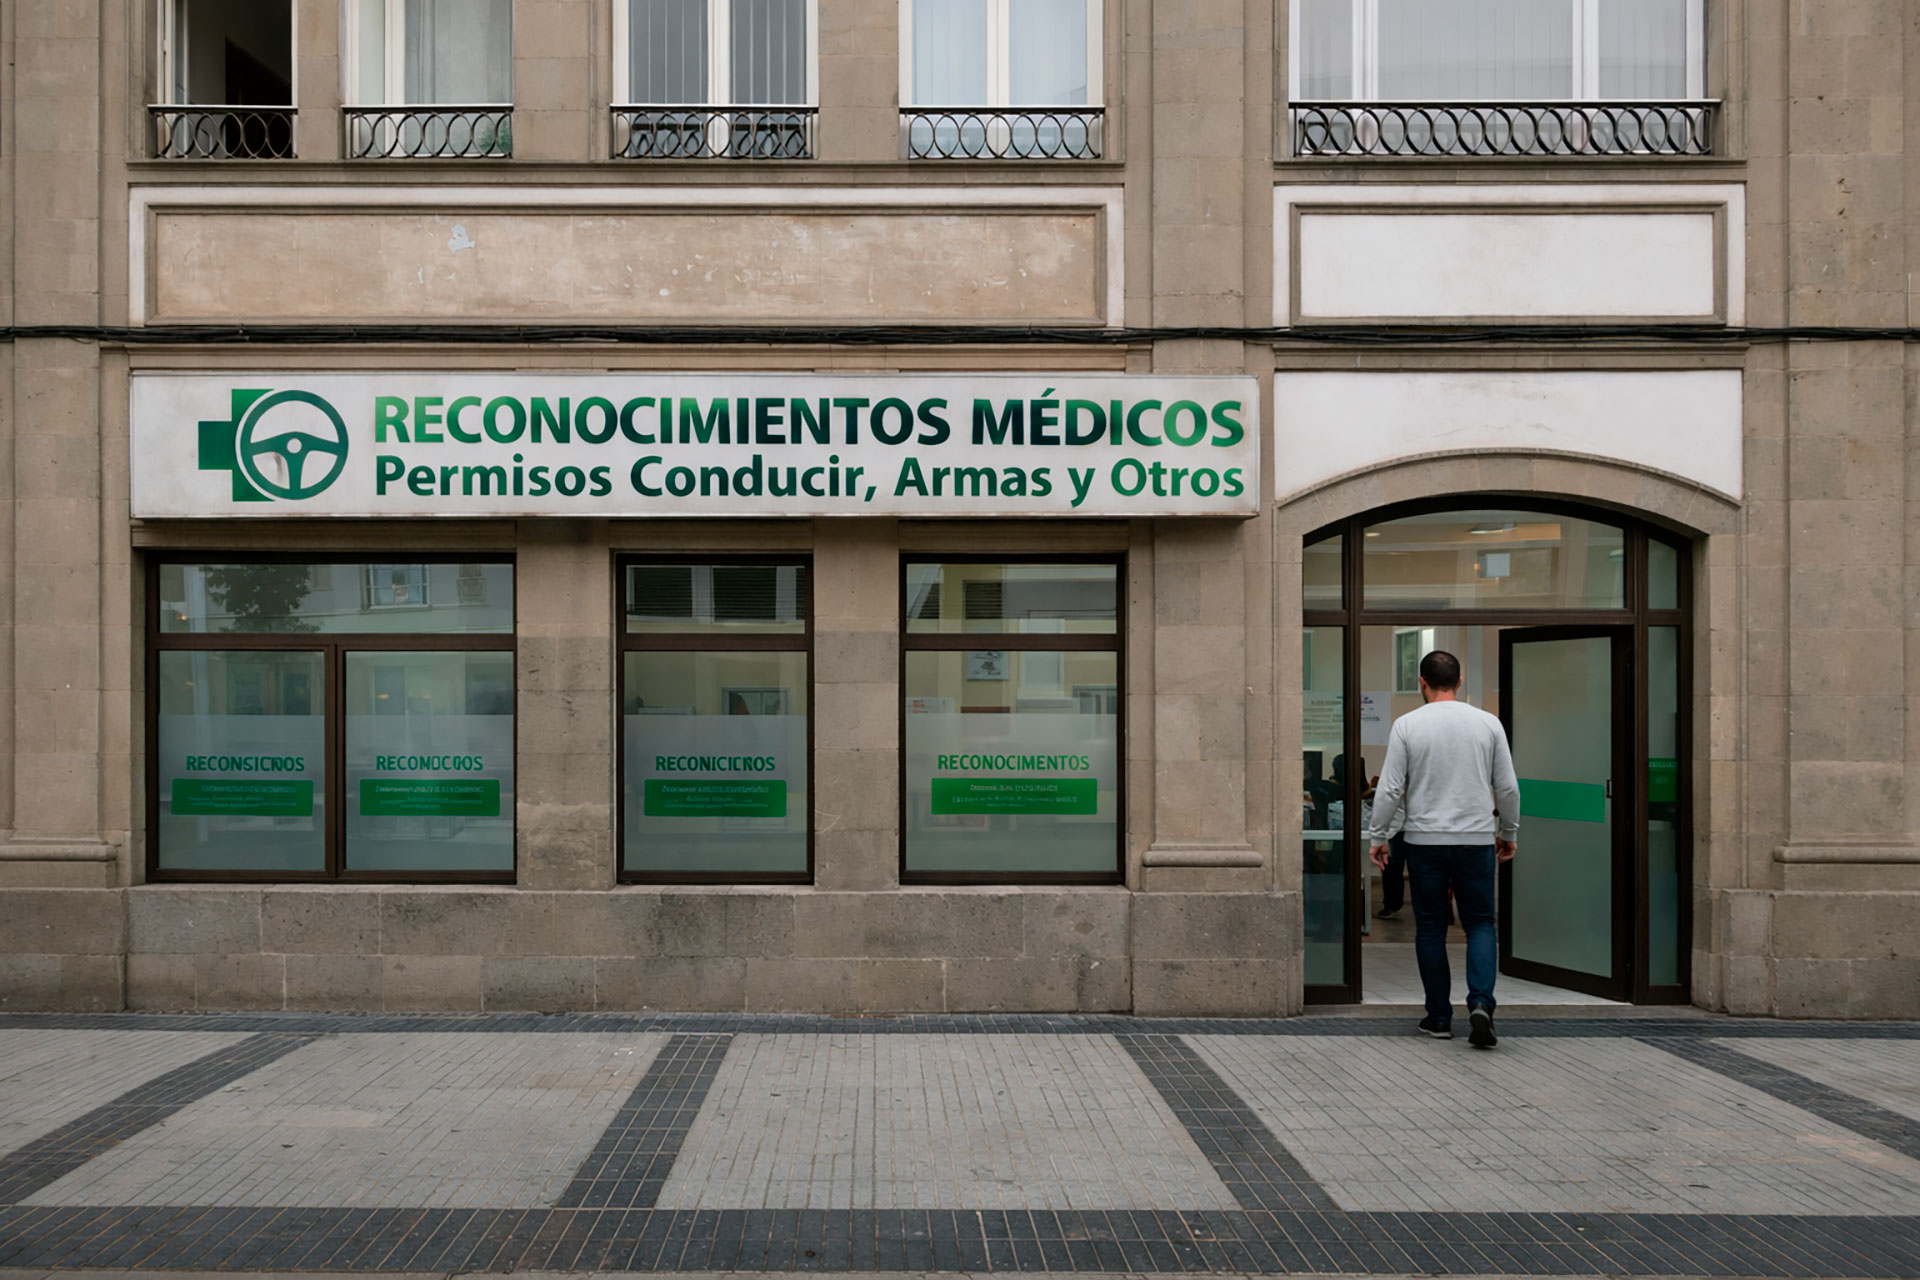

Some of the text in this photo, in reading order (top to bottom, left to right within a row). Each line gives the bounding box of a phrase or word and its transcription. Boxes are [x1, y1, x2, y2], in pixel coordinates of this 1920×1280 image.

[374, 387, 1245, 447] RECONOCIMIENTOS MÉDICOS
[375, 453, 1245, 508] Permisos Conducir, Armas y Otros
[937, 754, 1090, 771] RECONOCIMENTOS
